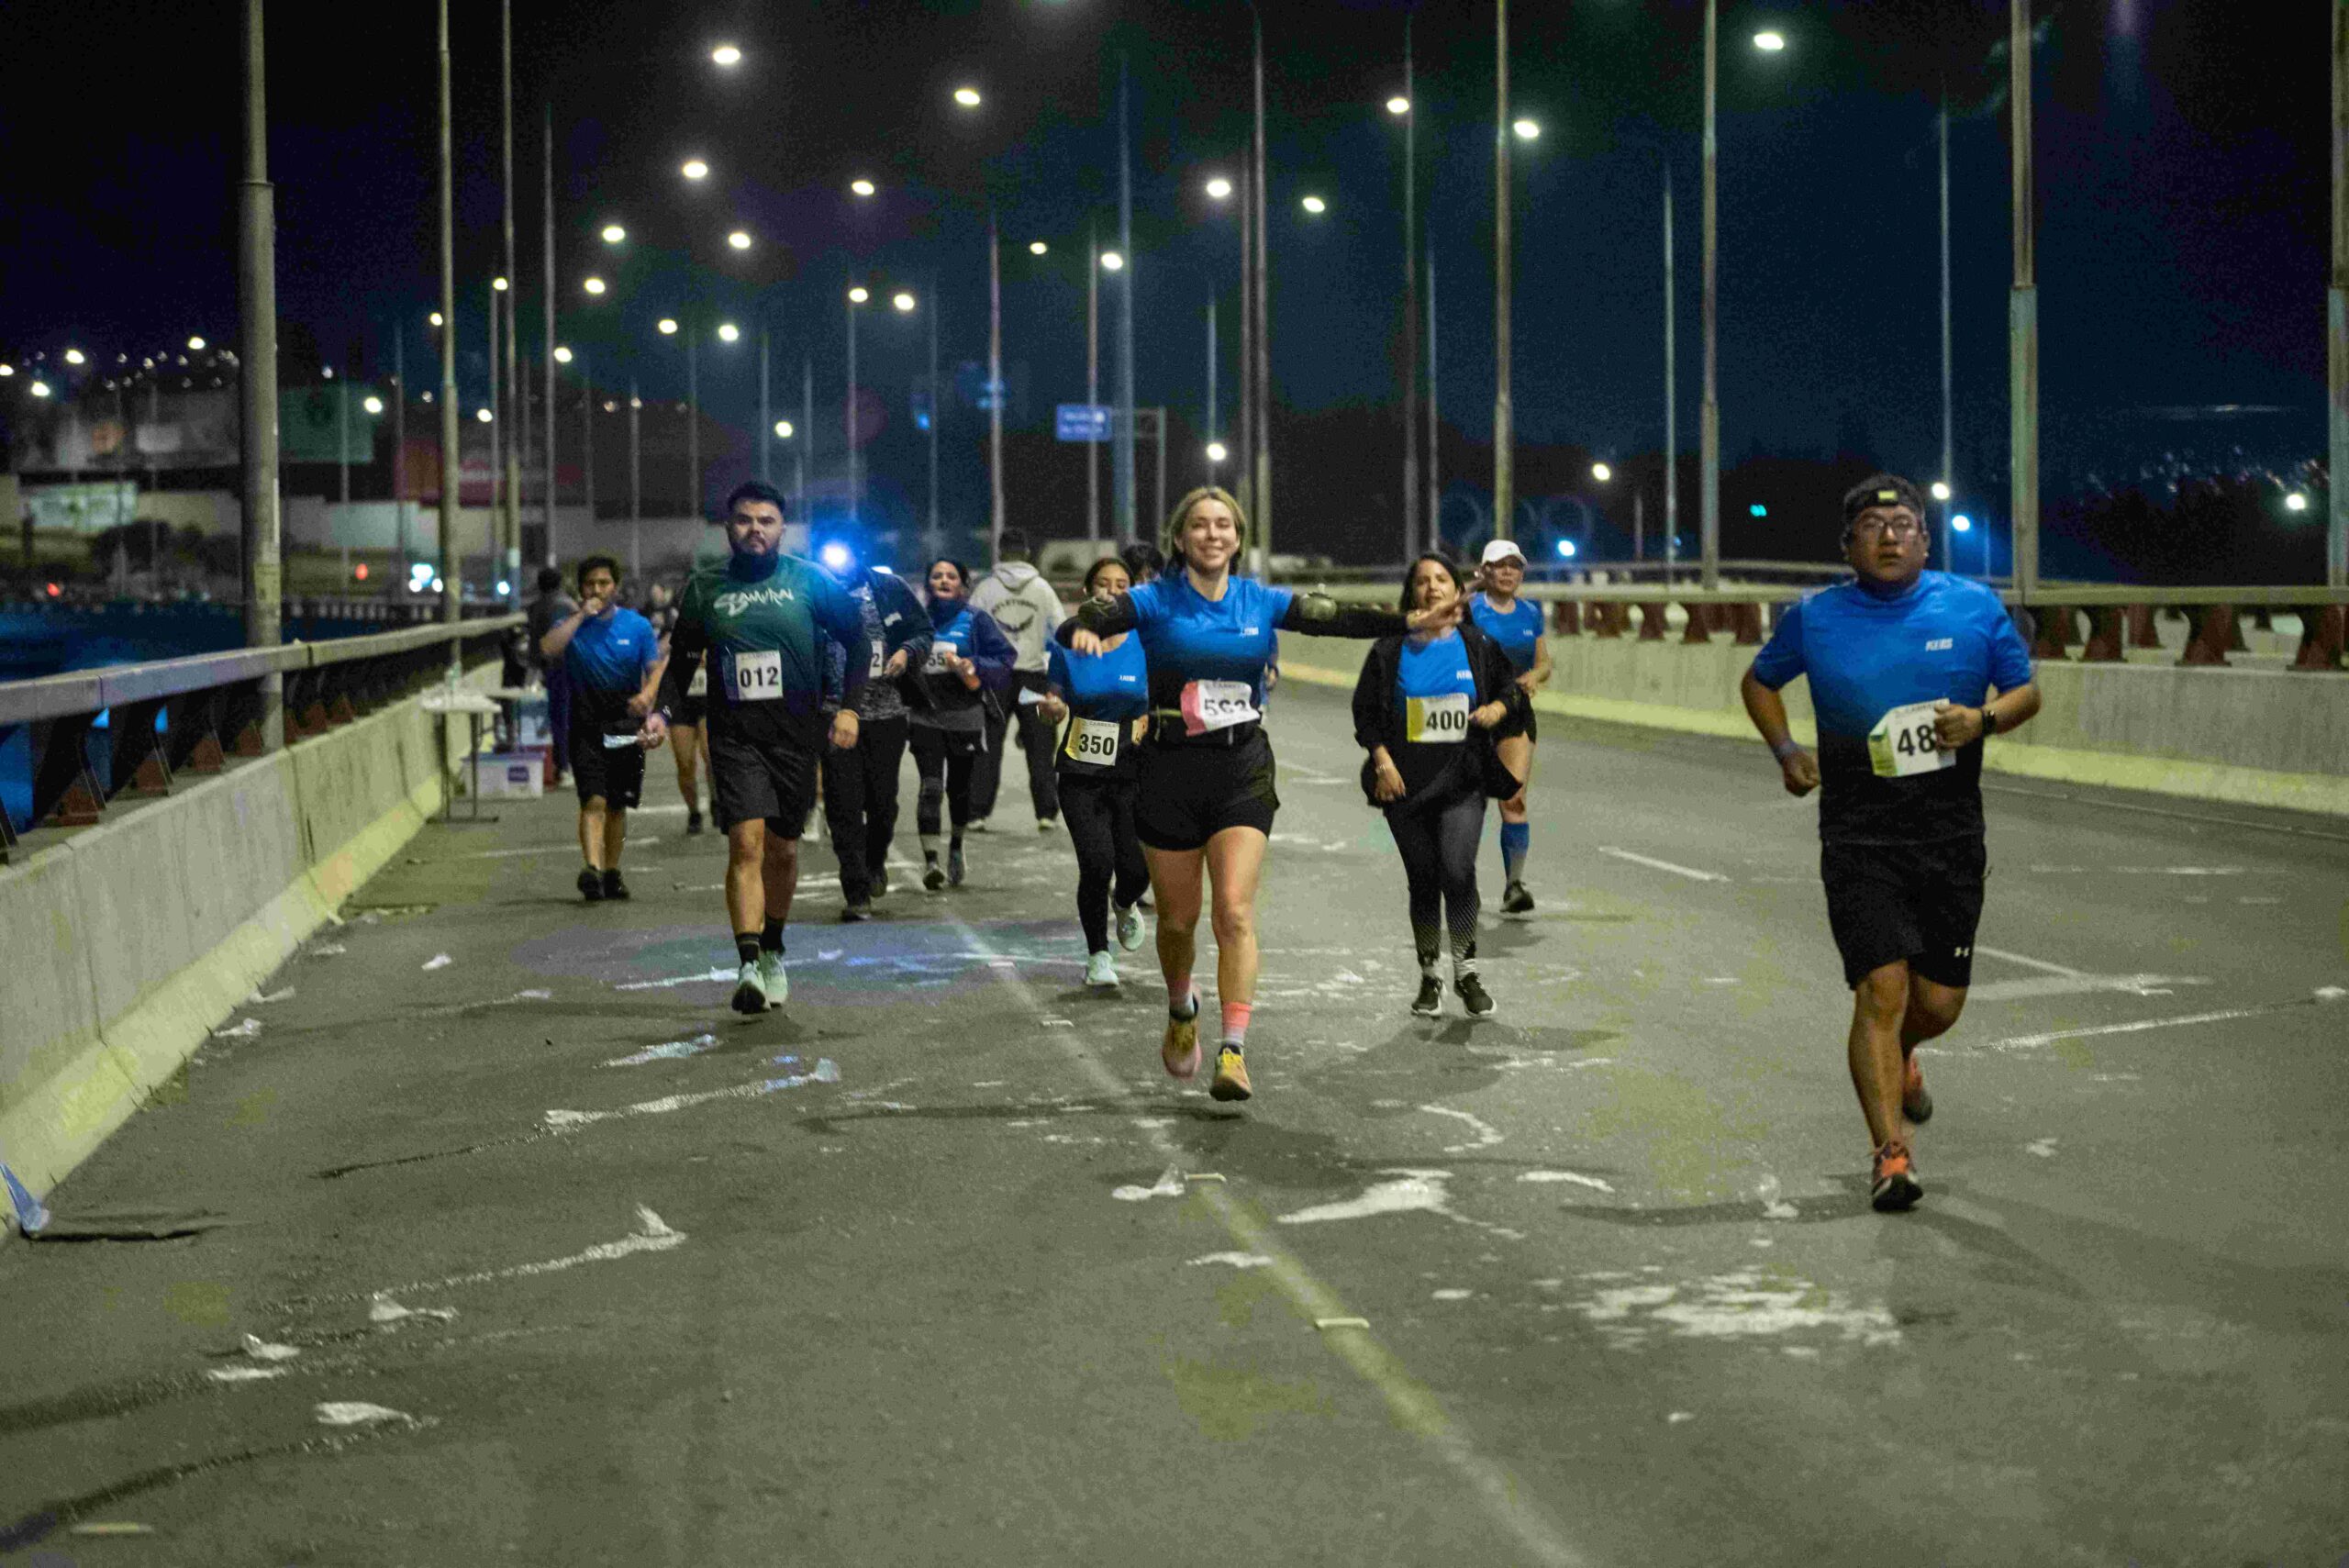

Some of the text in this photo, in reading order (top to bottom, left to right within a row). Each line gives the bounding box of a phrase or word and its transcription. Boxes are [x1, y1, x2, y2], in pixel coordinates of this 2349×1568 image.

[740, 665, 779, 688] 012
[1426, 709, 1466, 730] 400
[1078, 733, 1115, 756] 350
[1897, 724, 1936, 756] 48
